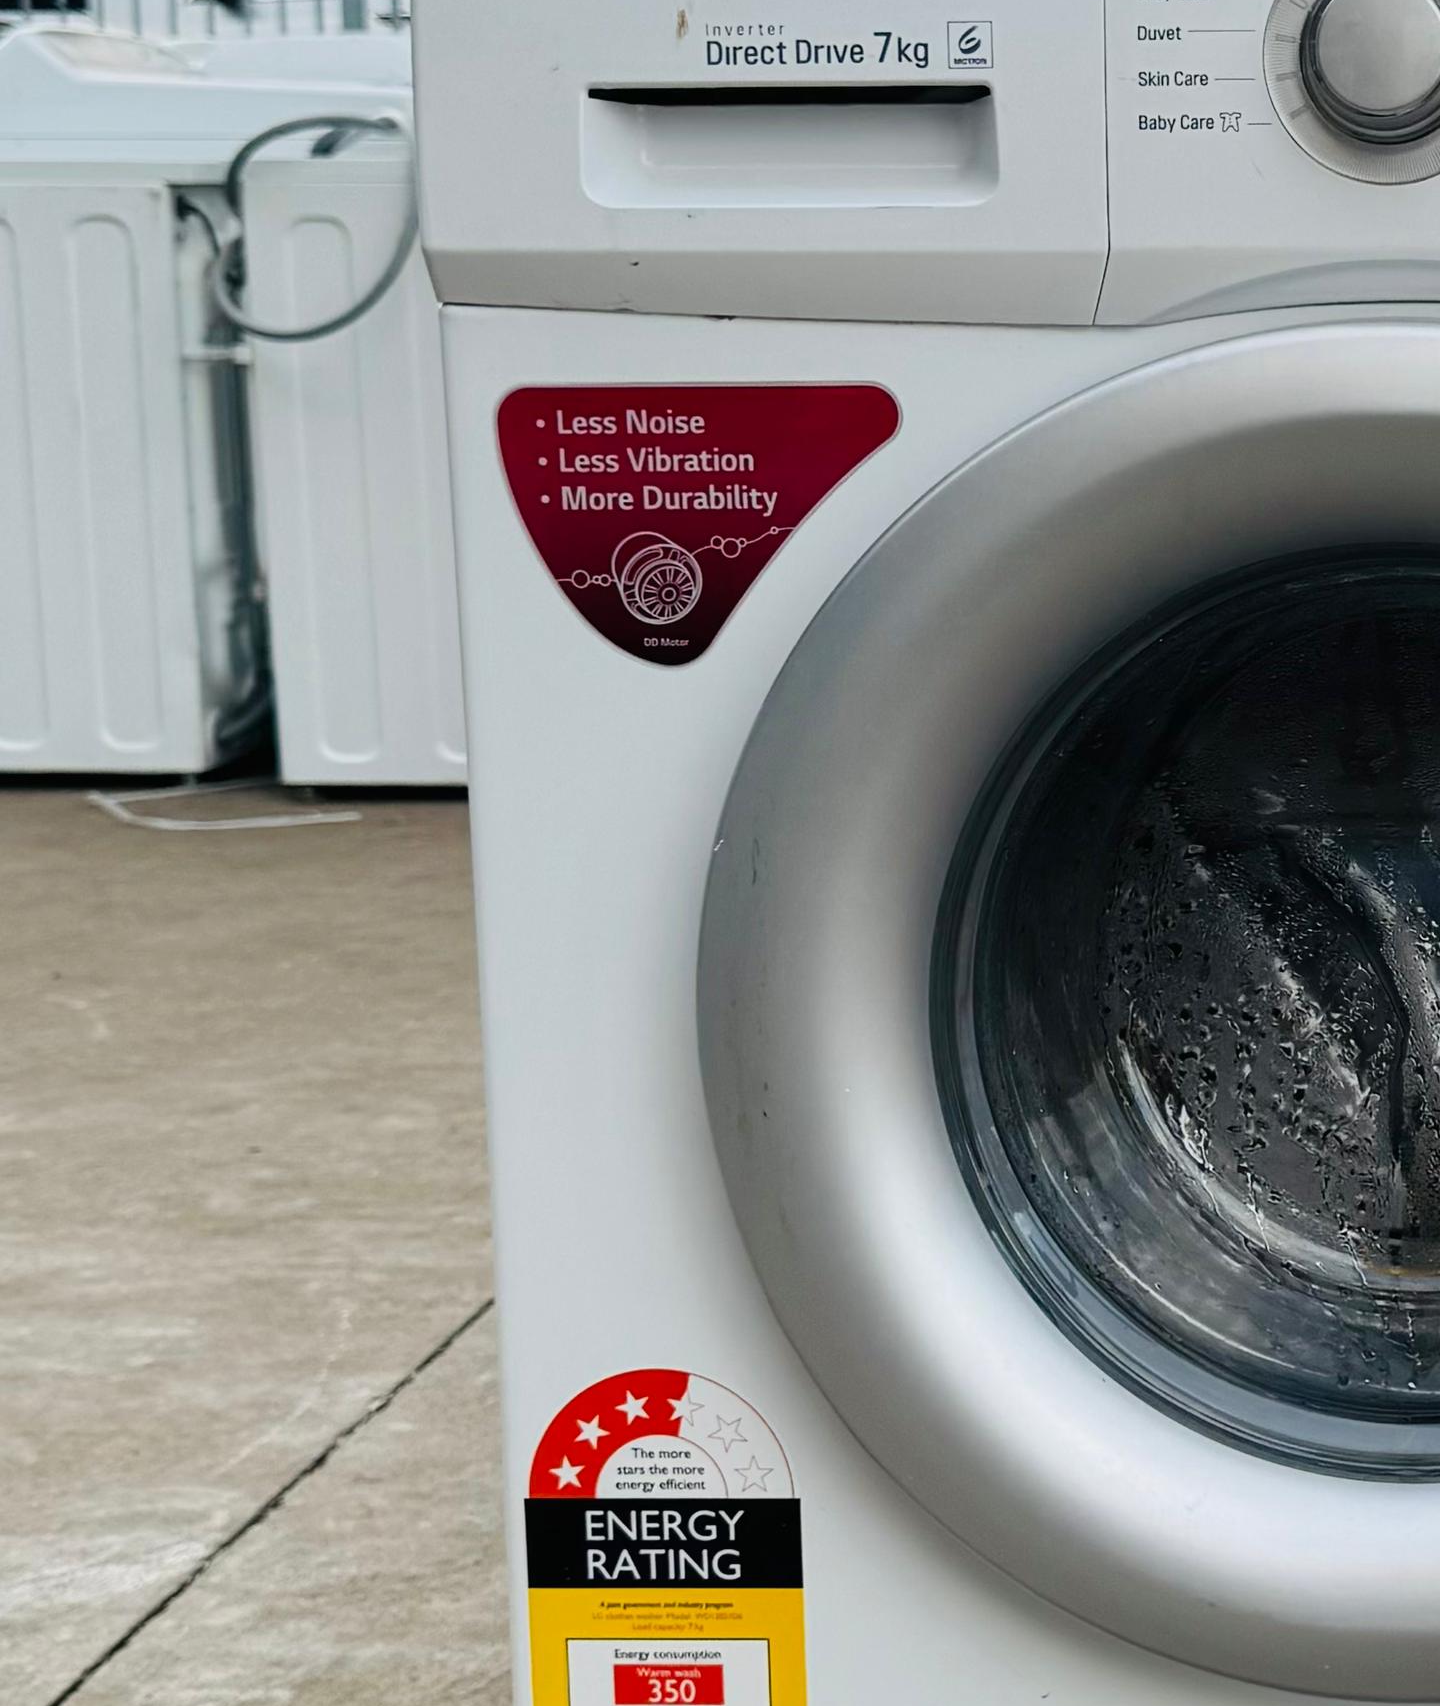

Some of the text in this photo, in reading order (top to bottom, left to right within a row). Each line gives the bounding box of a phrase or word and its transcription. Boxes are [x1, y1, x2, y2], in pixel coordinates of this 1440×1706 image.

[705, 22, 786, 37] Inverter
[1136, 25, 1182, 42] Duvet
[705, 39, 788, 66] Direct
[795, 38, 866, 65] Drive
[1137, 70, 1209, 87] Skin Care
[1137, 114, 1215, 134] Baby Care
[555, 408, 706, 436] Less Noise
[558, 446, 755, 475] Less Vibration
[561, 483, 778, 518] More Durability
[631, 1446, 692, 1460] The more
[616, 1464, 706, 1476] stars the more
[615, 1478, 707, 1493] energy efficient
[584, 1508, 746, 1542] ENERGY
[586, 1547, 742, 1581] RATING
[614, 1648, 723, 1662] Energy consumption
[636, 1666, 672, 1679] Warm
[647, 1679, 697, 1704] 350
